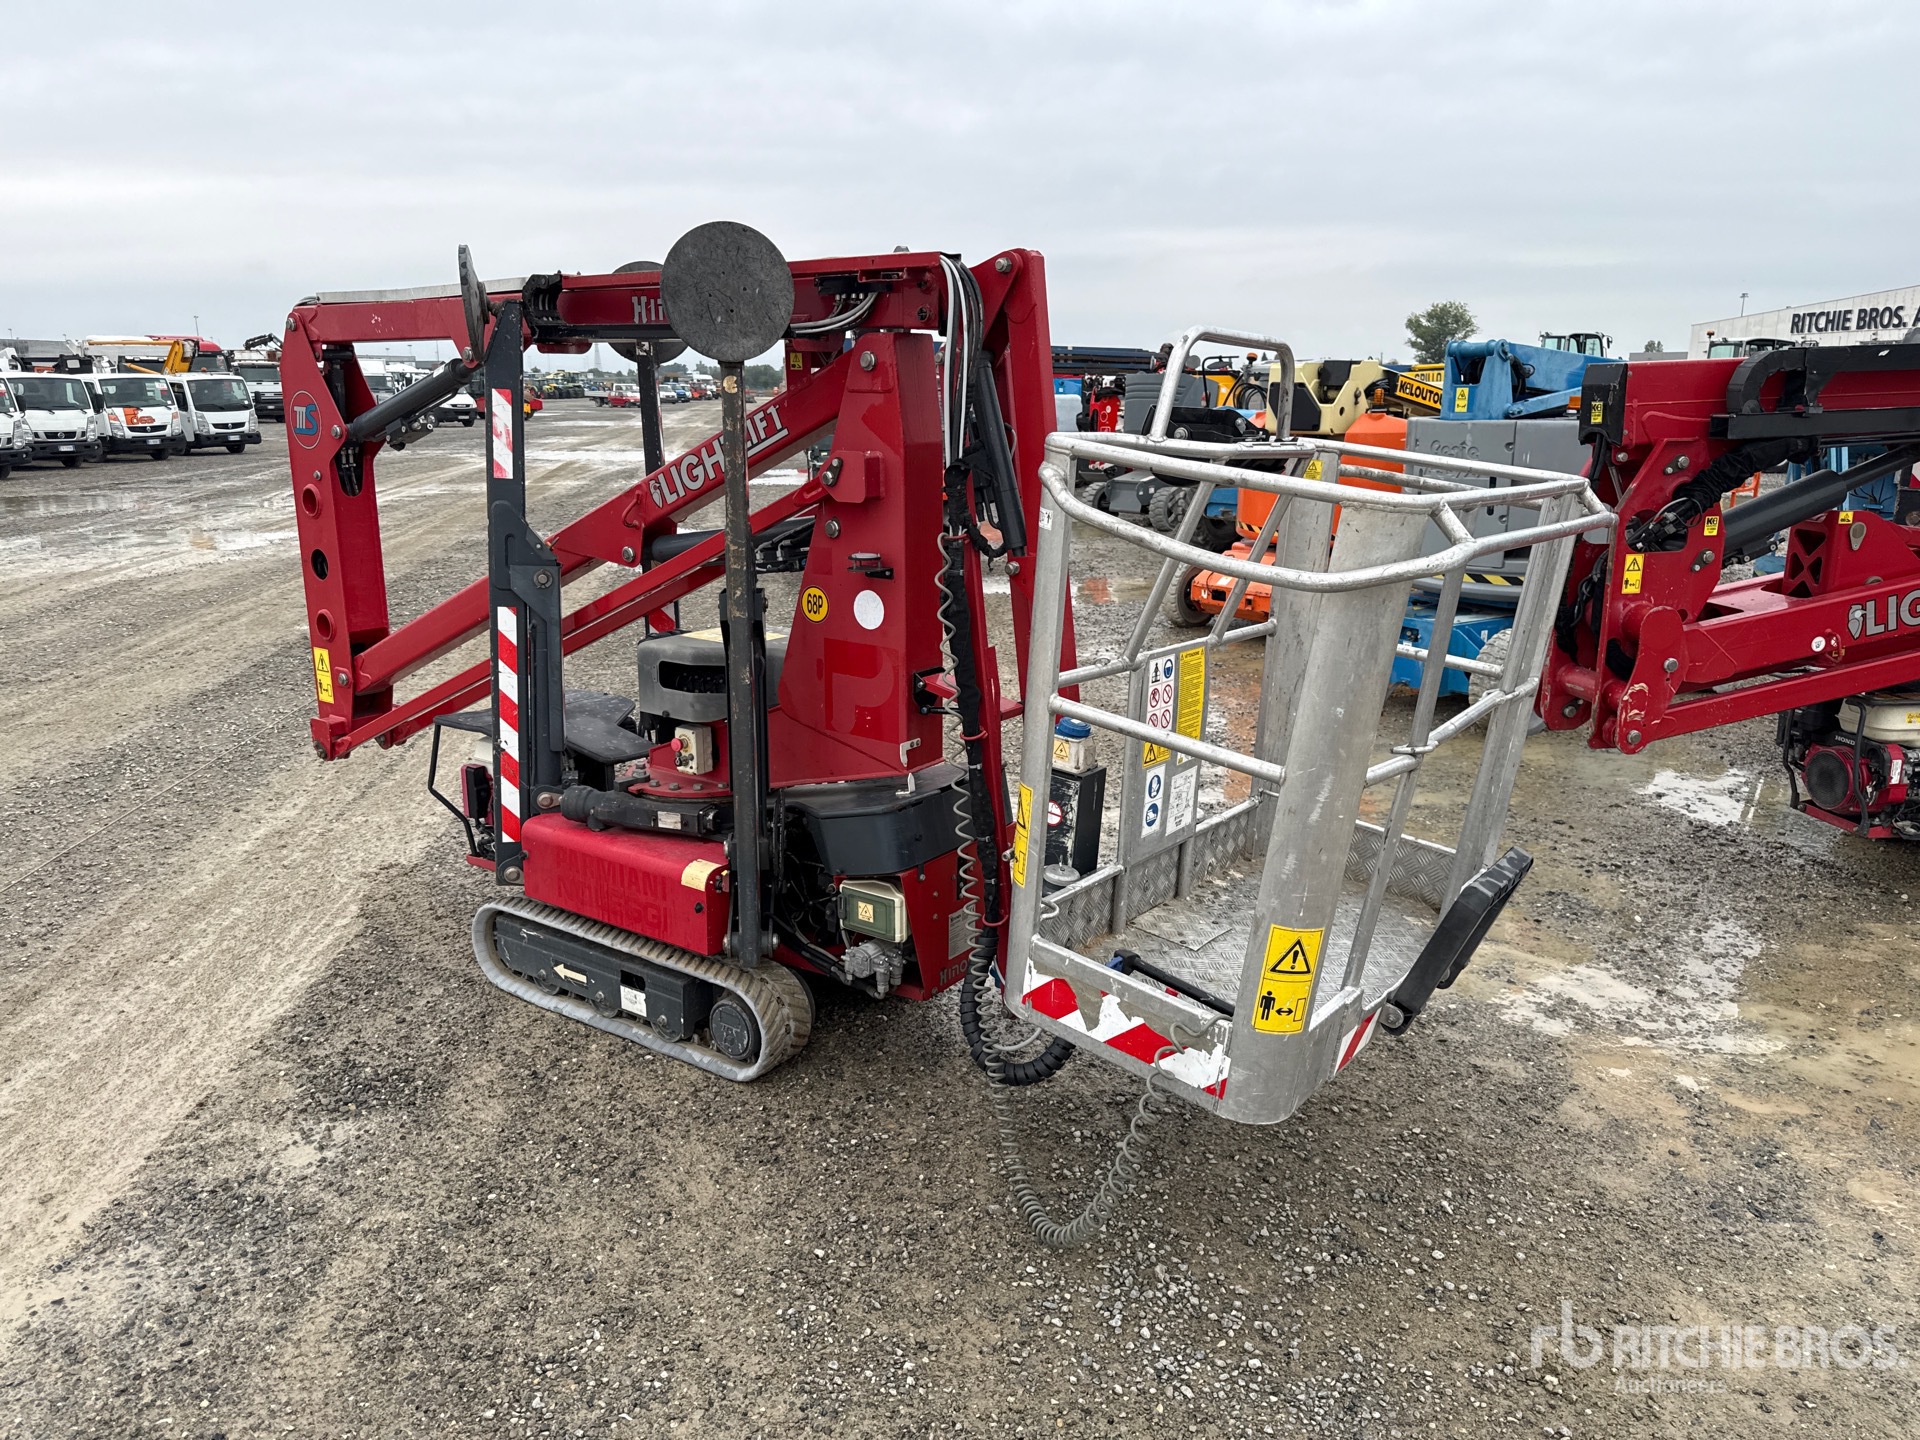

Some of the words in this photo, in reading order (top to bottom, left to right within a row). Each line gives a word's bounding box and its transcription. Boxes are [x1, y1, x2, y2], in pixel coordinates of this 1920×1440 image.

[1790, 309, 1853, 334] RITCHIE
[1855, 305, 1908, 330] BROS.
[806, 593, 824, 615] 68P
[1834, 734, 1856, 746] HOND
